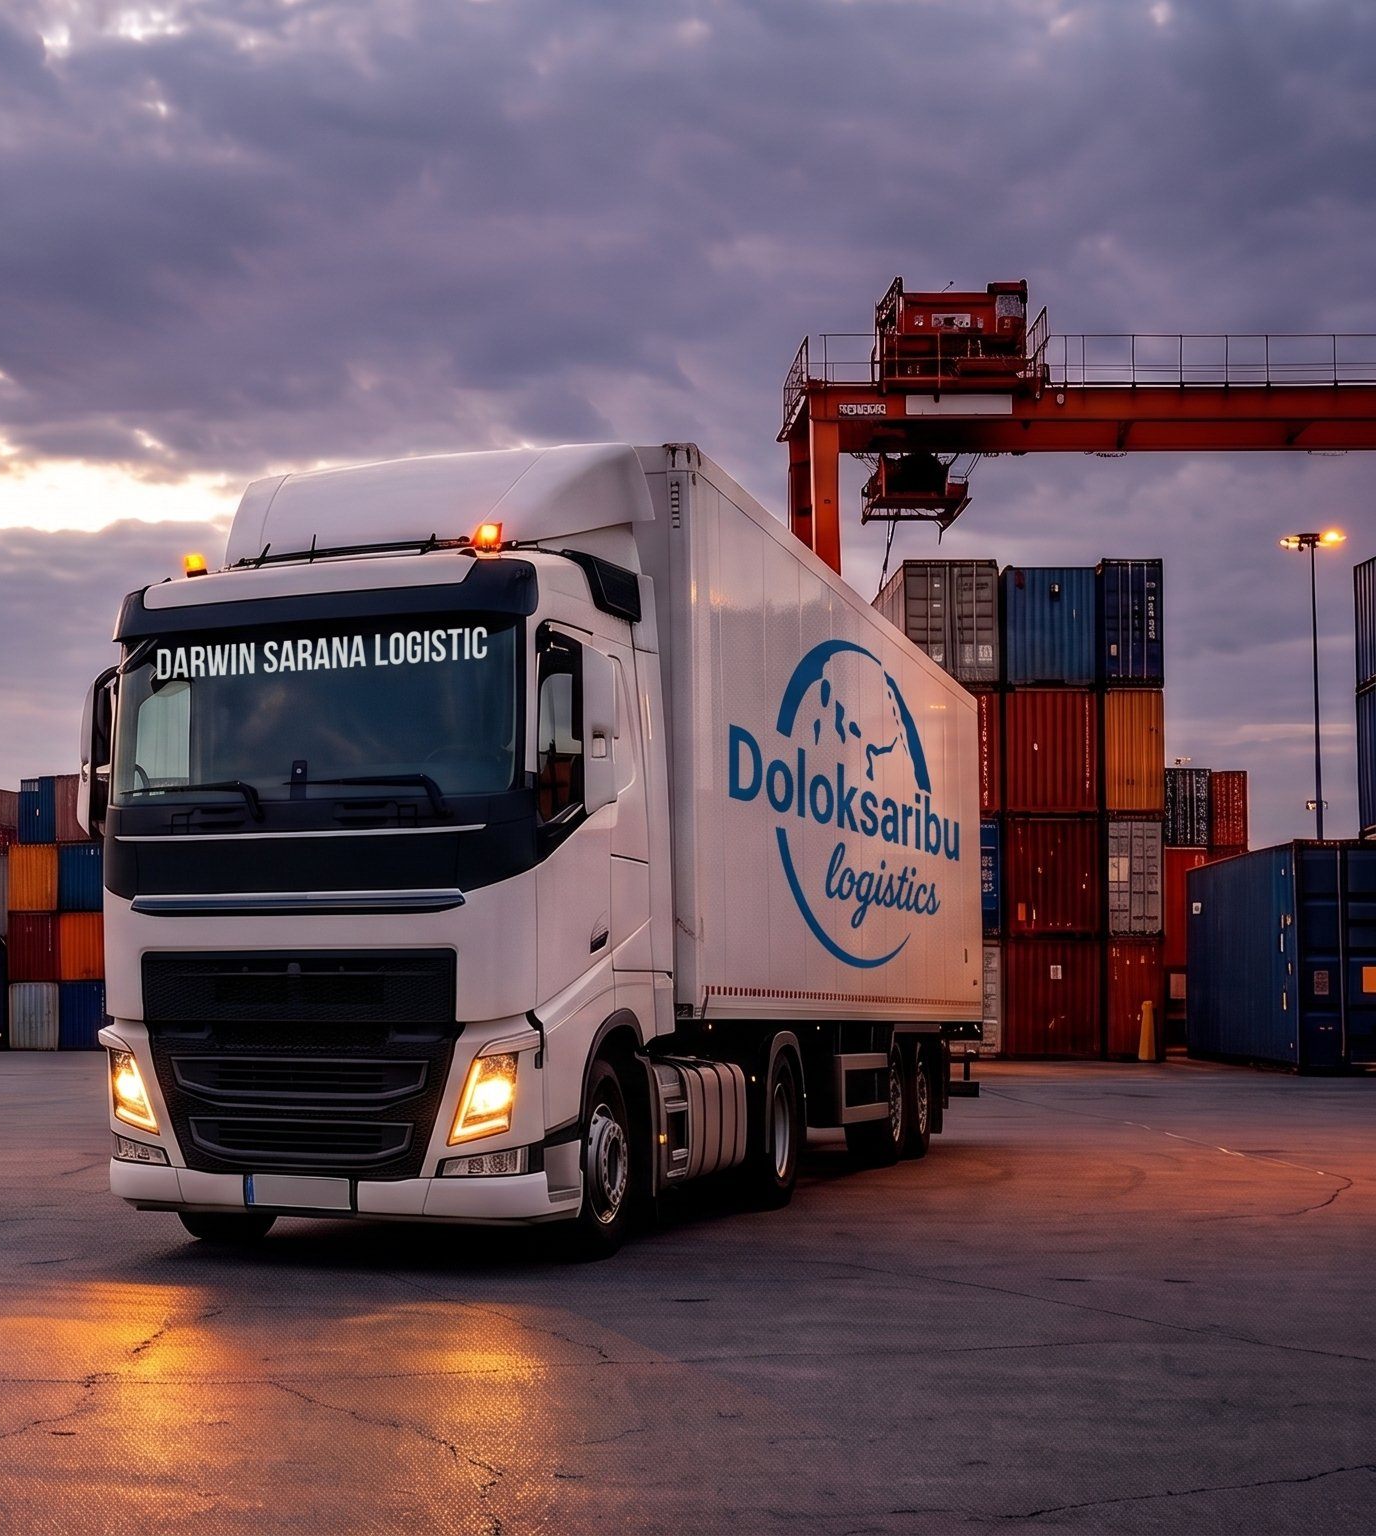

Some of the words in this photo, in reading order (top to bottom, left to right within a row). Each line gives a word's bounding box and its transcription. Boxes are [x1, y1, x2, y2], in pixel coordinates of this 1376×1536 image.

[156, 642, 255, 680] DARWIN
[263, 635, 367, 673] SARANA
[374, 626, 488, 666] LOGISTIC
[729, 723, 960, 861] Doloksaribu
[825, 842, 941, 929] logistics
